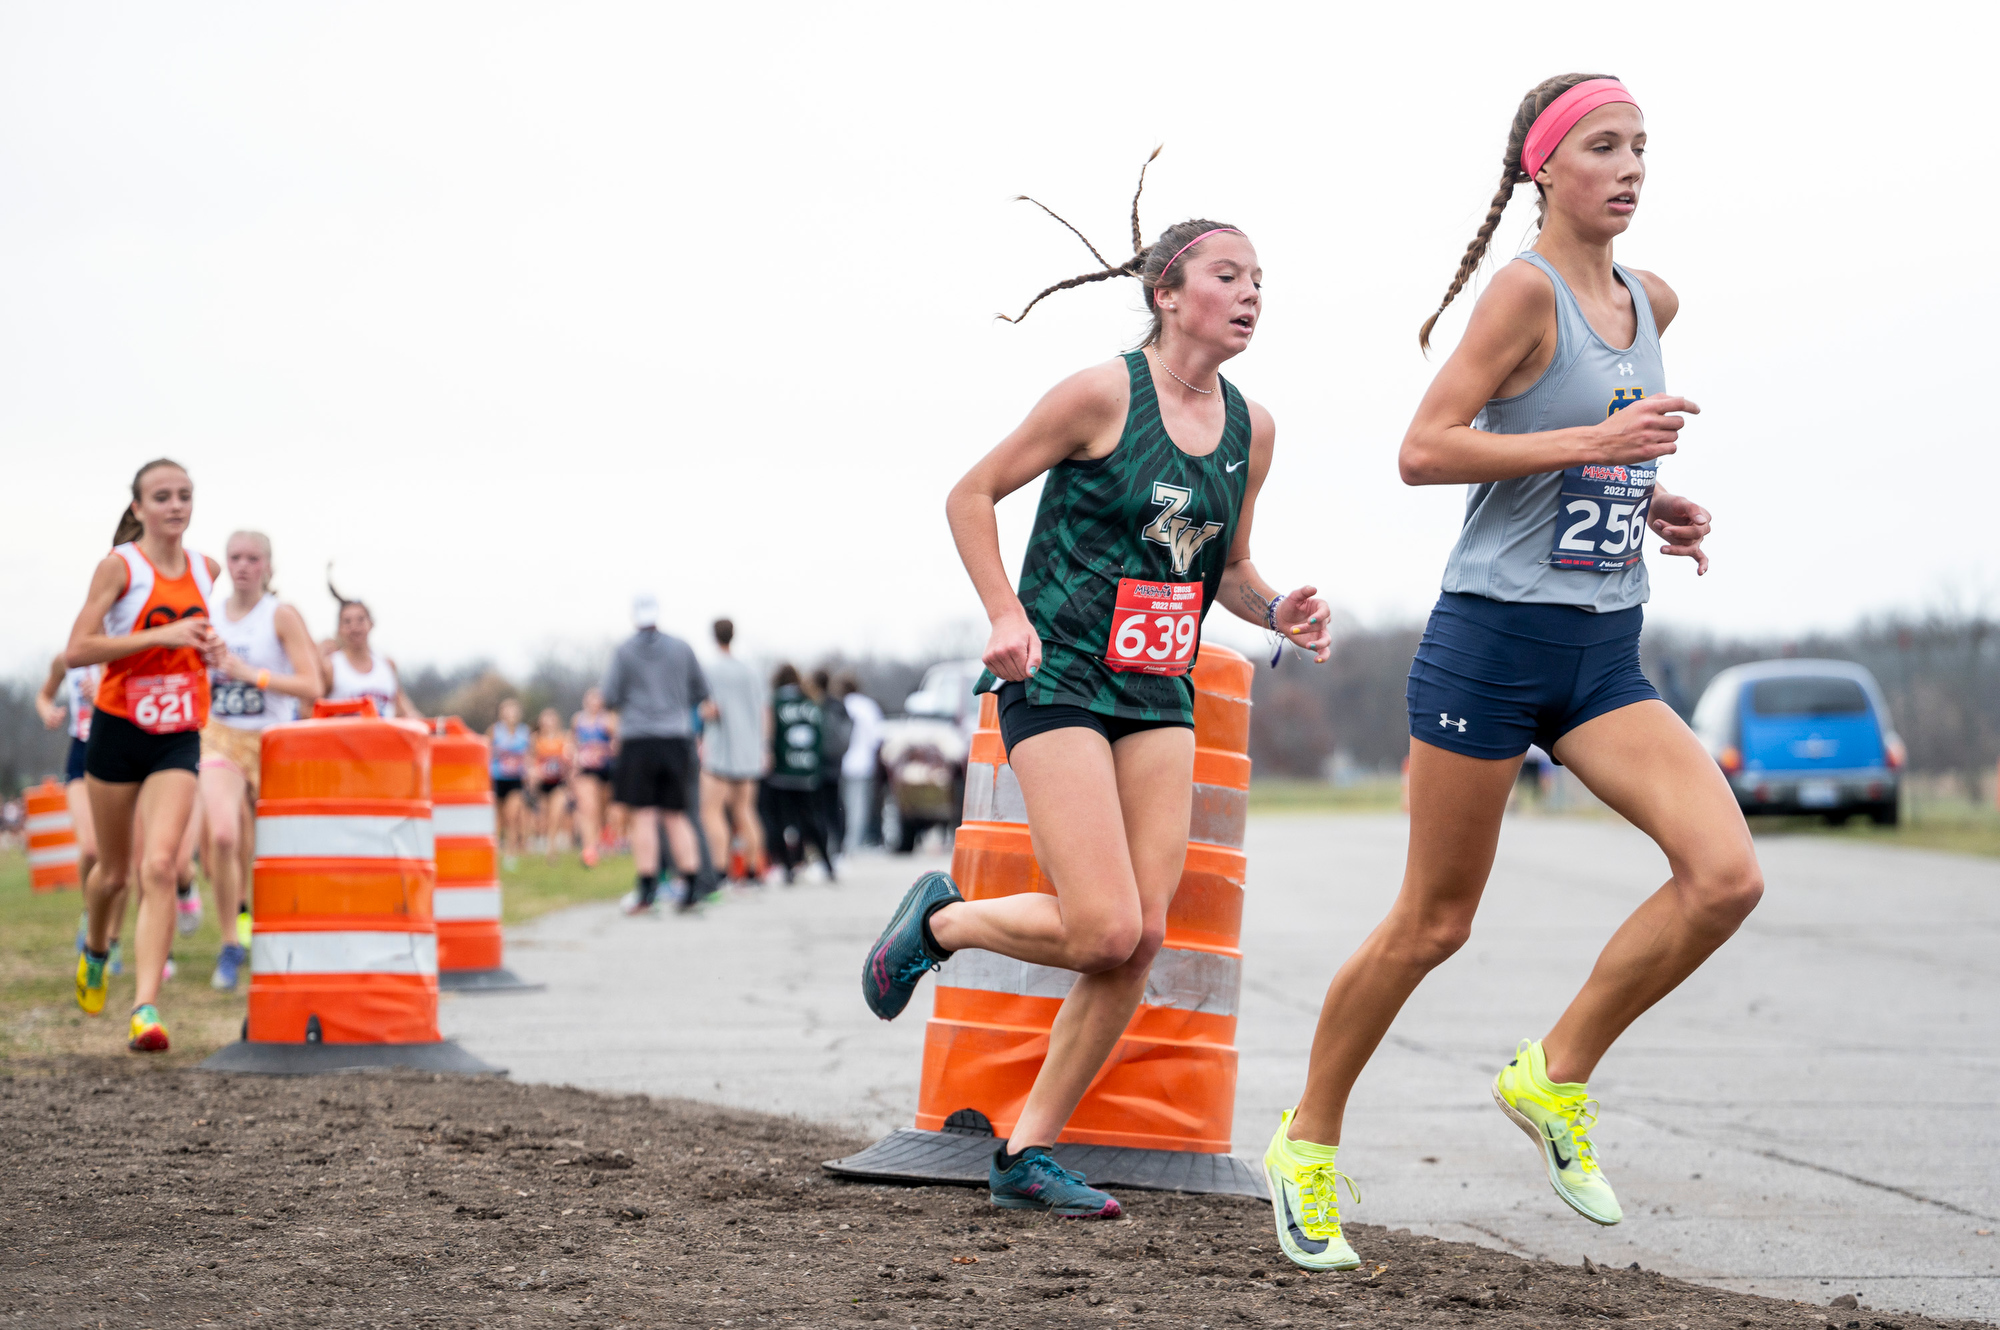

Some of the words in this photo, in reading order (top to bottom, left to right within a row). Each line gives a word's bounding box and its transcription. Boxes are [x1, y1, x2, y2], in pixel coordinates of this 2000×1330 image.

[1582, 465, 1628, 481] MHSAA
[1630, 470, 1655, 479] CROS
[1603, 485, 1626, 496] 2022
[1559, 498, 1648, 554] 256
[1134, 584, 1171, 597] MHSAA
[1151, 601, 1168, 610] 2022
[1115, 614, 1195, 660] 639
[135, 691, 193, 726] 621
